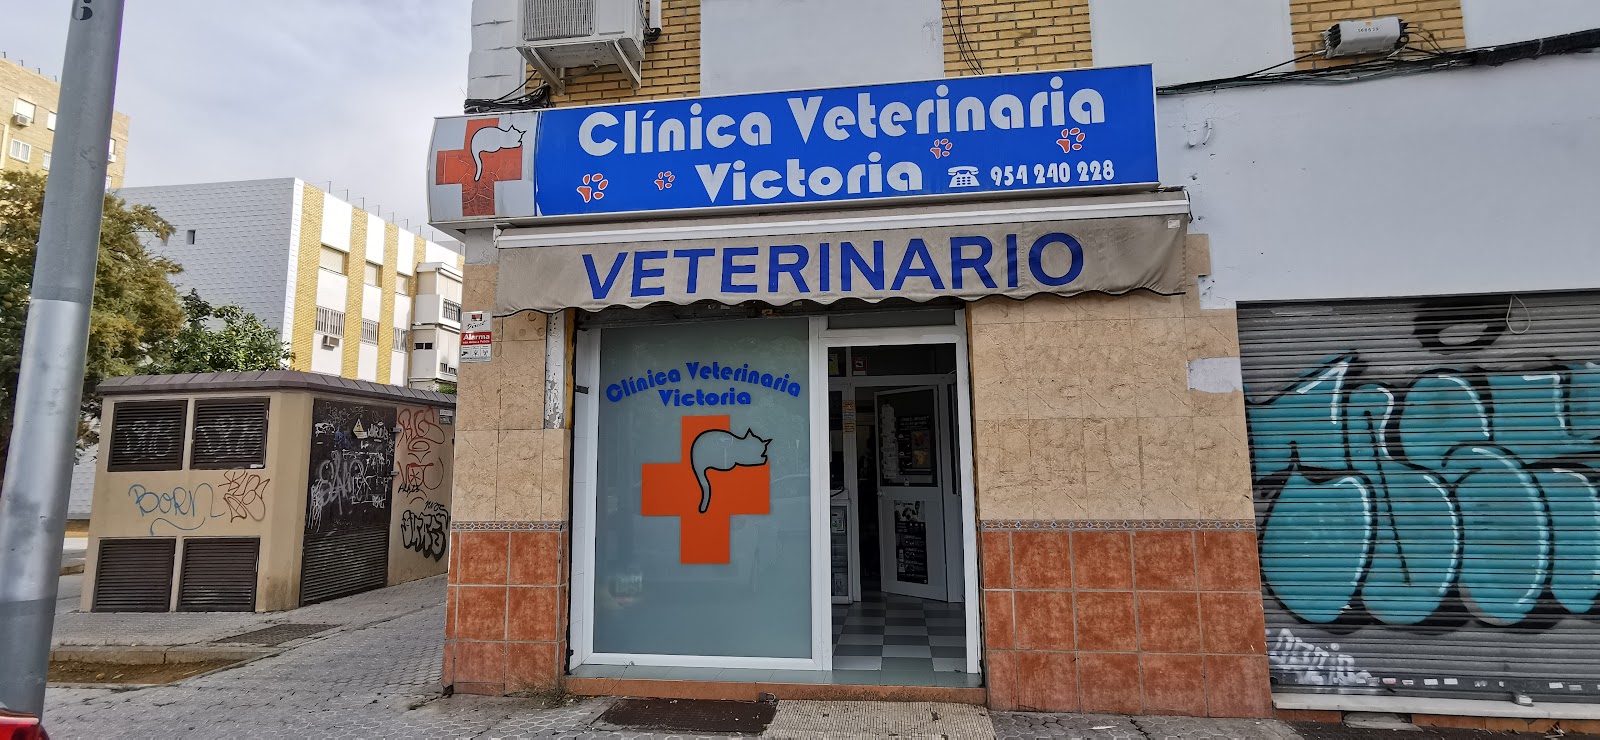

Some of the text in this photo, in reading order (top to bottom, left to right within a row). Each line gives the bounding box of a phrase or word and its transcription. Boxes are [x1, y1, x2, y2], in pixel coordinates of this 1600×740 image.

[578, 77, 1105, 157] Clínica Veterinaria
[694, 152, 923, 203] Victoria
[990, 159, 1115, 187] 954 240 228
[582, 233, 1084, 300] VETERINARIO
[463, 333, 490, 341] Alarma
[605, 361, 801, 403] Clínica Veterinaria
[658, 387, 752, 407] Victoria
